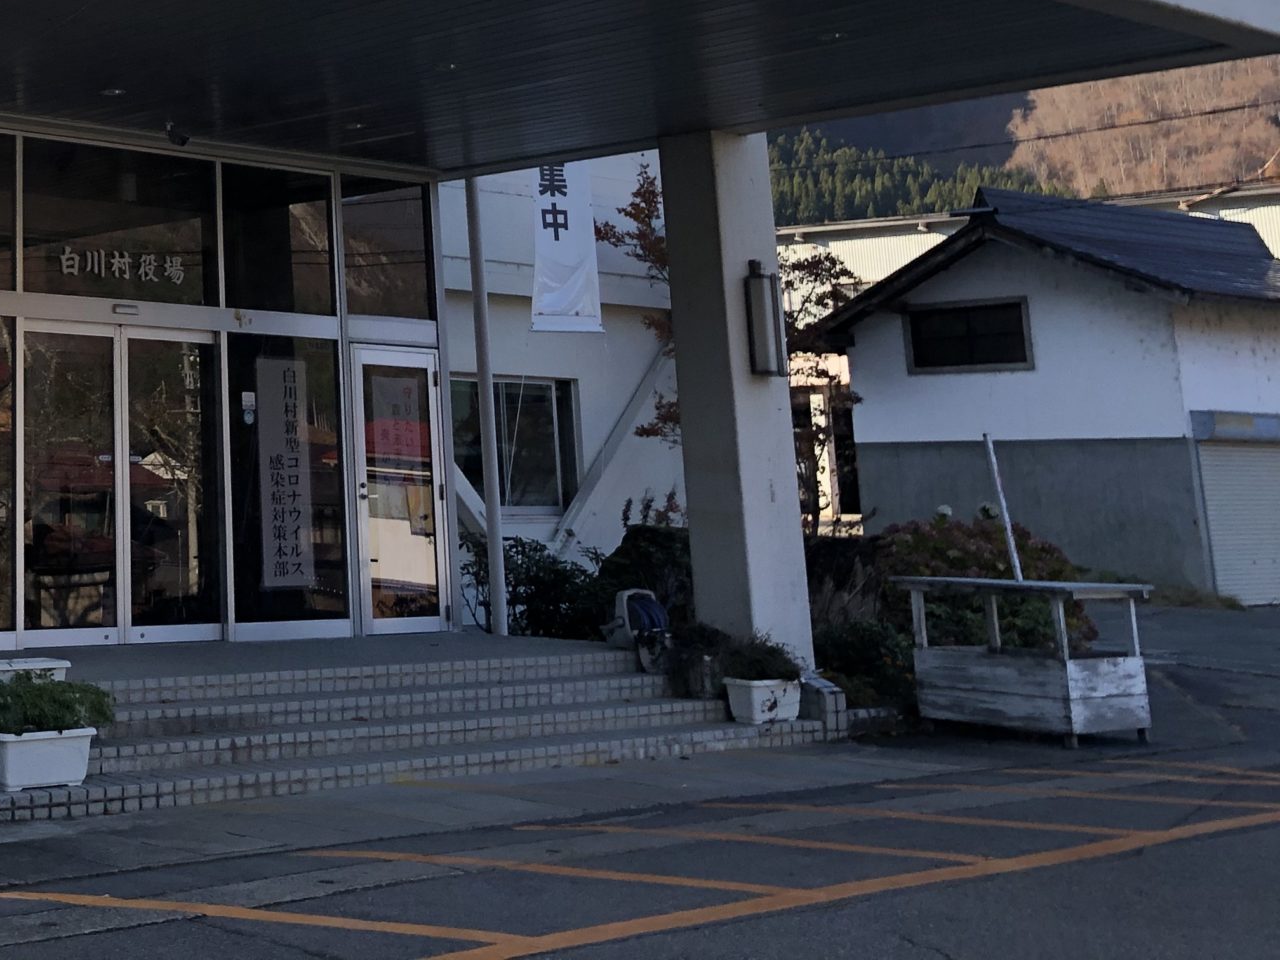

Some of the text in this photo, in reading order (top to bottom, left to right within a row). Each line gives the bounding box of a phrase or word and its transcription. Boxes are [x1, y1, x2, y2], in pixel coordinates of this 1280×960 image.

[60, 246, 185, 285] 白川村役場
[269, 454, 289, 577] 感染症対策本部
[282, 367, 304, 576] 白川村新型コロナウイルス
